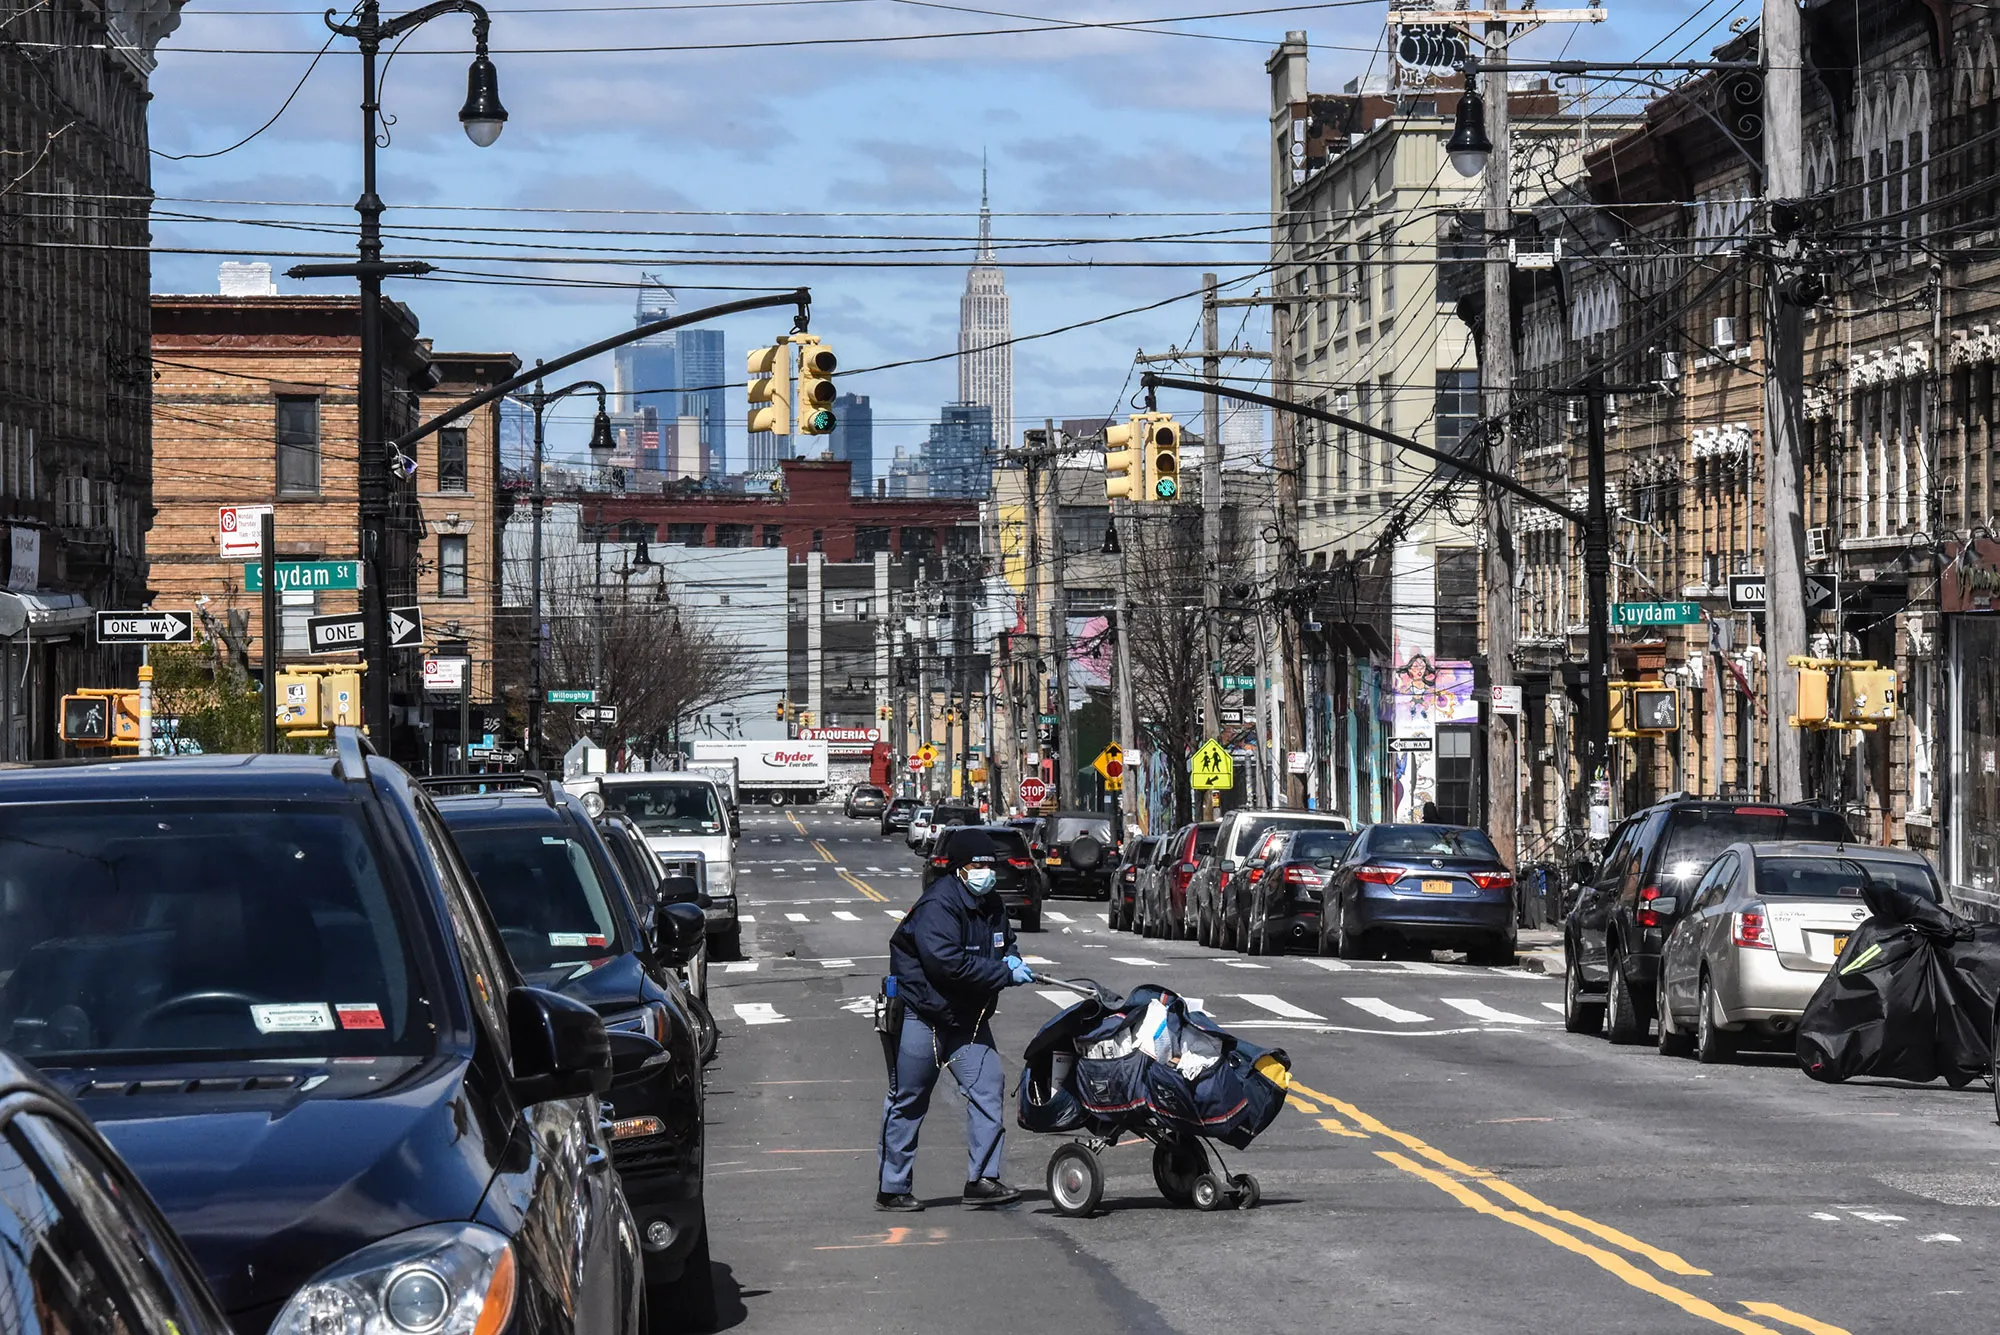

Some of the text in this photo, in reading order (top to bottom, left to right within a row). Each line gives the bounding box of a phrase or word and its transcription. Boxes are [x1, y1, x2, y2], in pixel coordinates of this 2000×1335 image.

[257, 565, 348, 591] Sydam St
[1745, 587, 1765, 599] ON
[1619, 605, 1691, 625] Suydam St
[111, 621, 178, 633] ONE WAY
[325, 624, 358, 641] ONE
[552, 691, 589, 700] Willoughby
[1041, 715, 1057, 724] Starr
[813, 730, 867, 739] TAQUERIA
[774, 751, 814, 763] Ryder
[1021, 786, 1044, 796] STOP
[263, 1015, 324, 1024] 3 21
